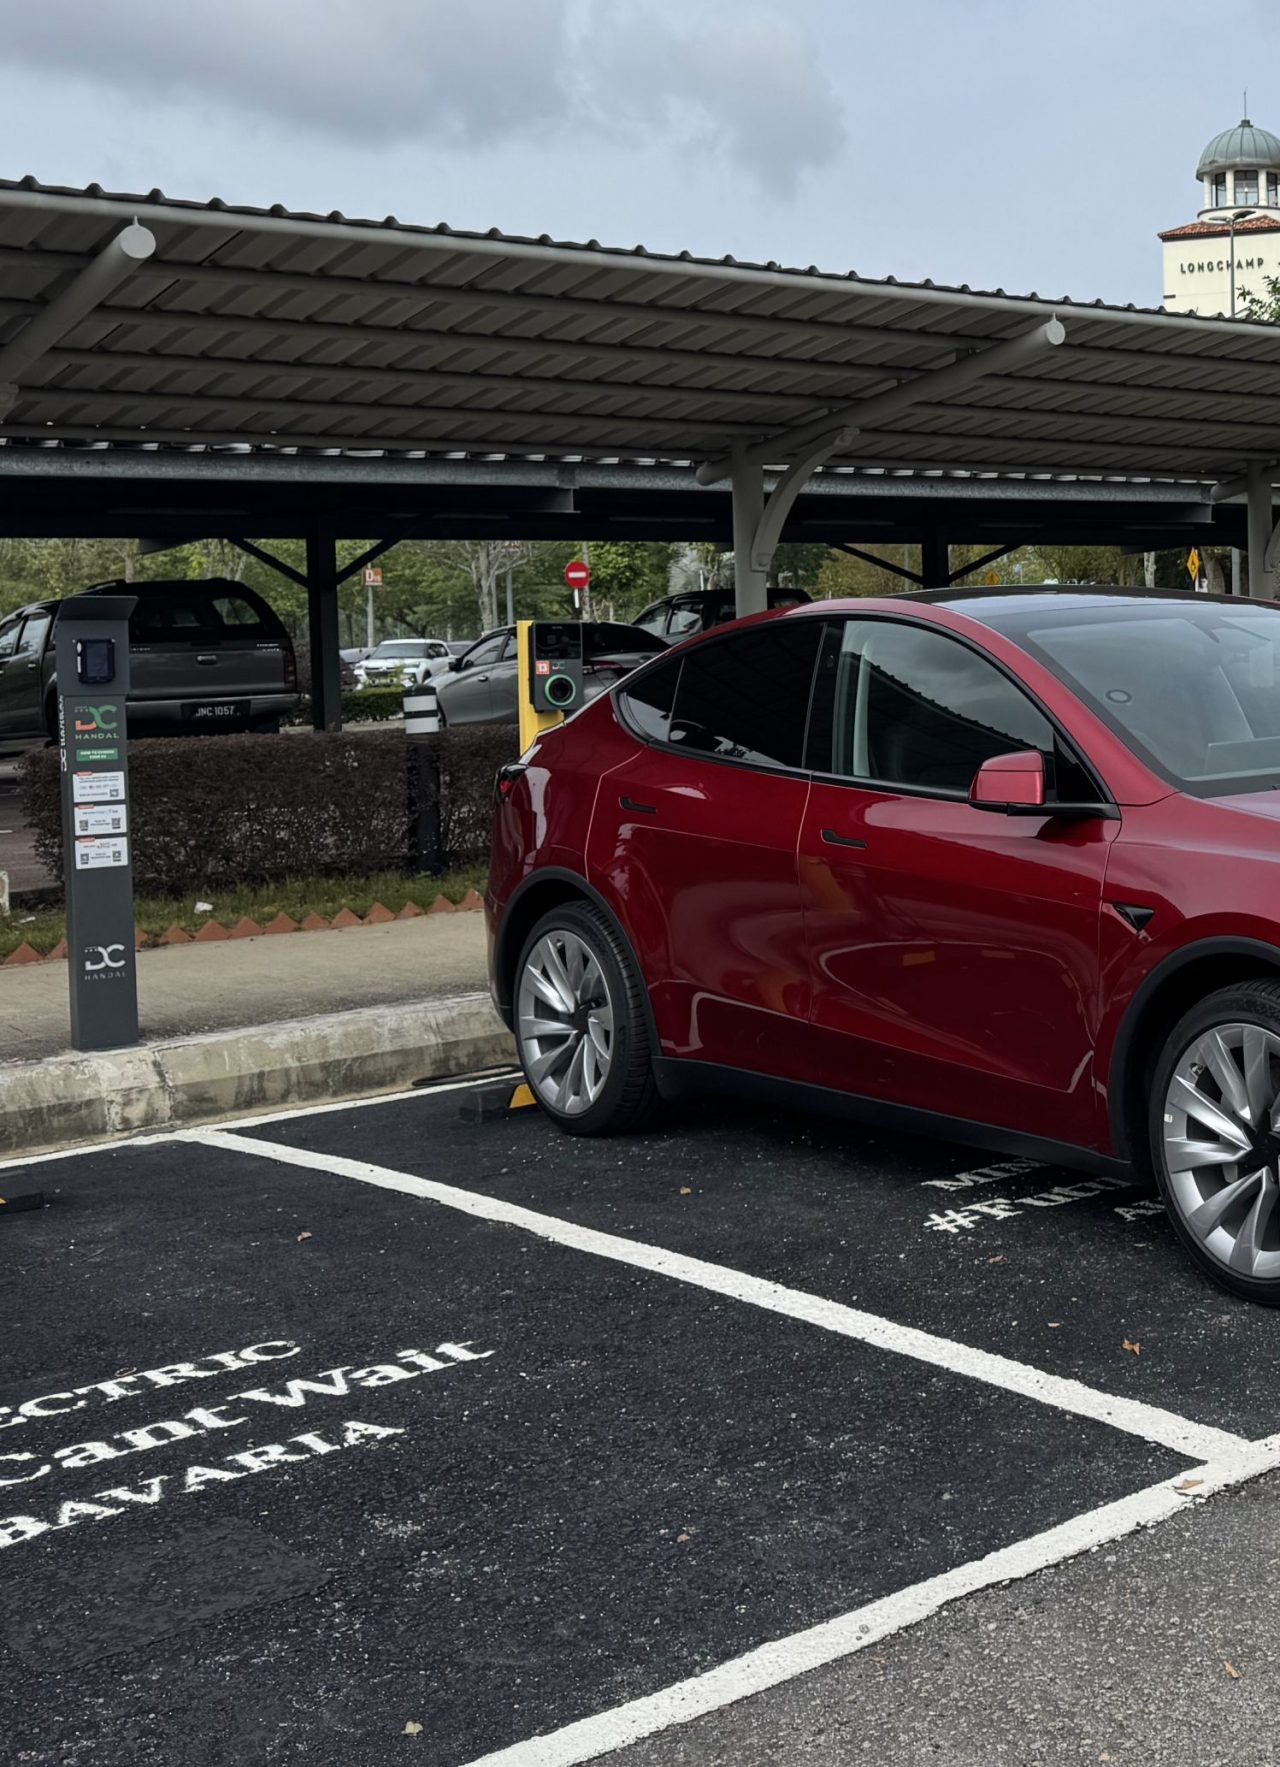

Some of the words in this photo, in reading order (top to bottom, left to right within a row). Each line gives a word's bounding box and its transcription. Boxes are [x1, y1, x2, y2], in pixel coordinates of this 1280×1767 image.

[1180, 257, 1264, 274] LONGCHAMP
[214, 705, 236, 716] 1057
[75, 732, 120, 740] HANDAL
[84, 971, 126, 981] HANDAL
[227, 1340, 497, 1407] Wait
[0, 1420, 406, 1549] BAVARIA
